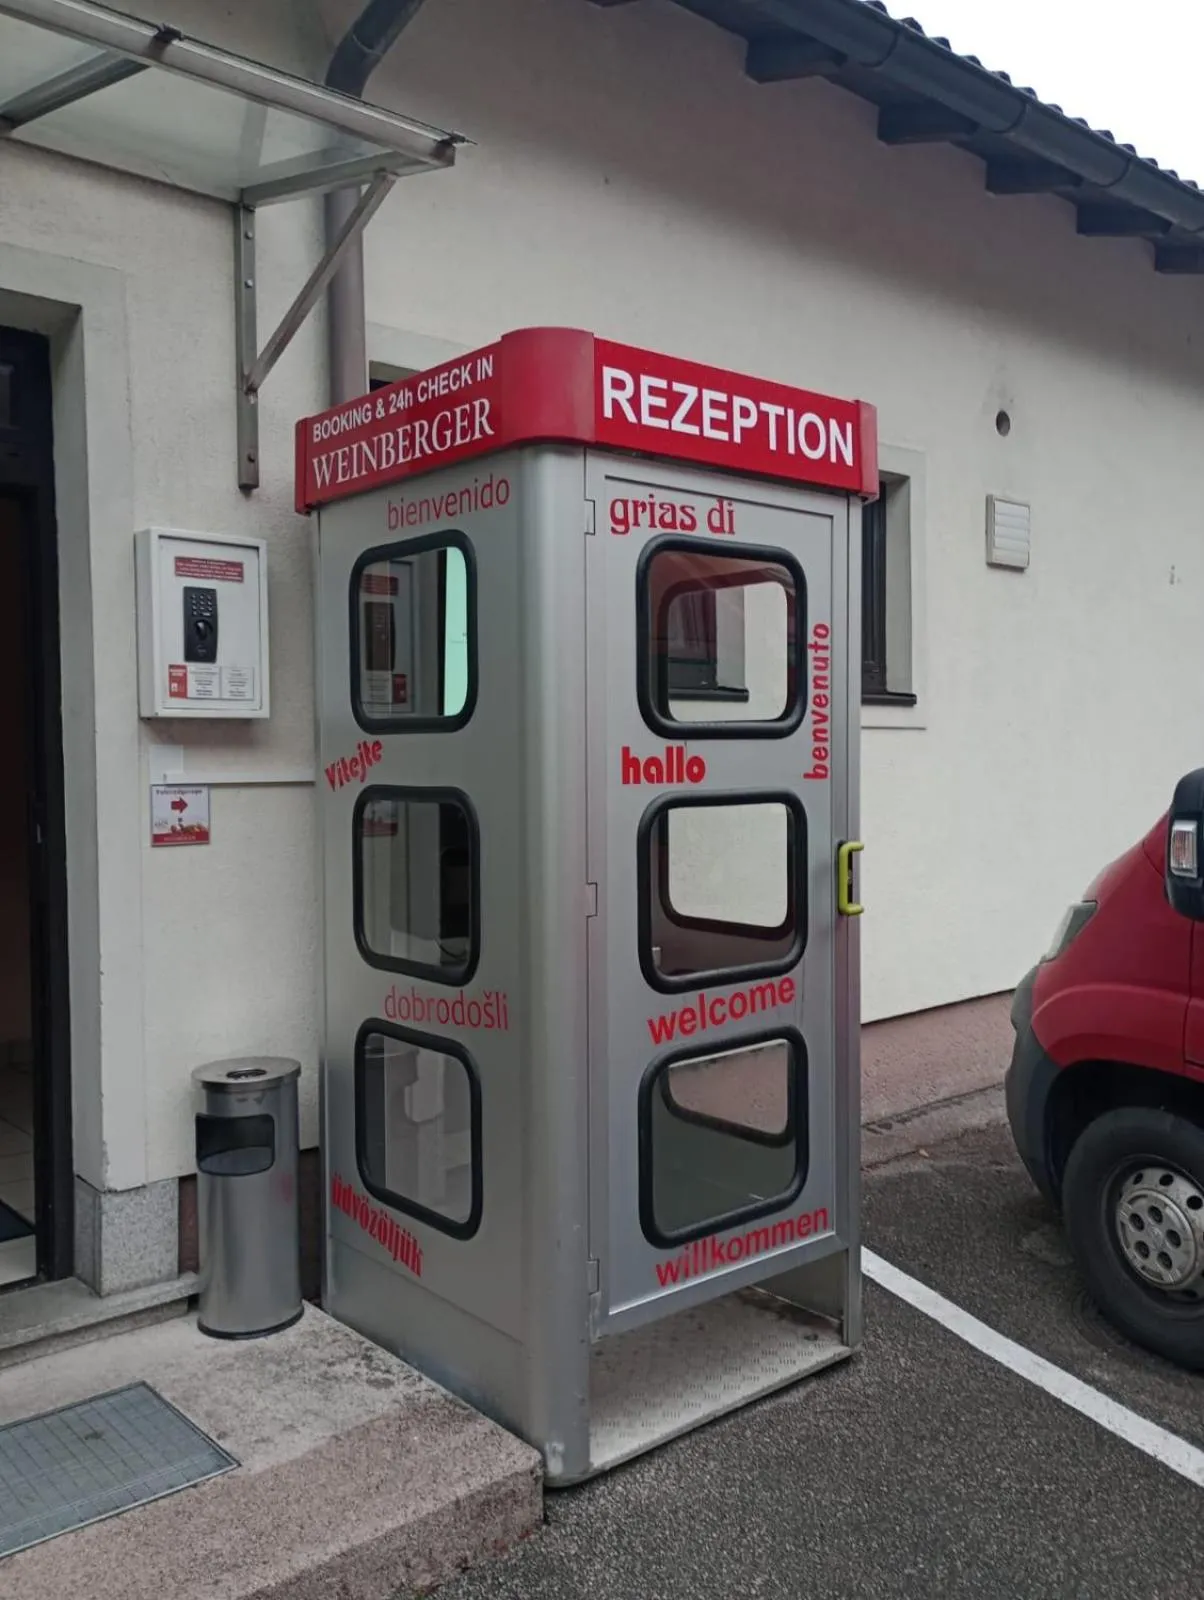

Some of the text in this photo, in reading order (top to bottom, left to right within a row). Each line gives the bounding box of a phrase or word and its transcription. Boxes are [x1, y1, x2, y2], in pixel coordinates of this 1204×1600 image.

[313, 355, 494, 442] BOOKING & 24h CHECK IN
[602, 365, 853, 467] REZEPTION
[312, 398, 495, 489] WEINBERGER
[388, 473, 510, 530] bienvenido
[609, 494, 735, 535] grias di
[803, 623, 830, 780] benvenuto
[621, 746, 706, 785] hallo
[384, 984, 509, 1030] dobrodošli
[647, 976, 795, 1045] welcome
[656, 1207, 829, 1287] willkommen
